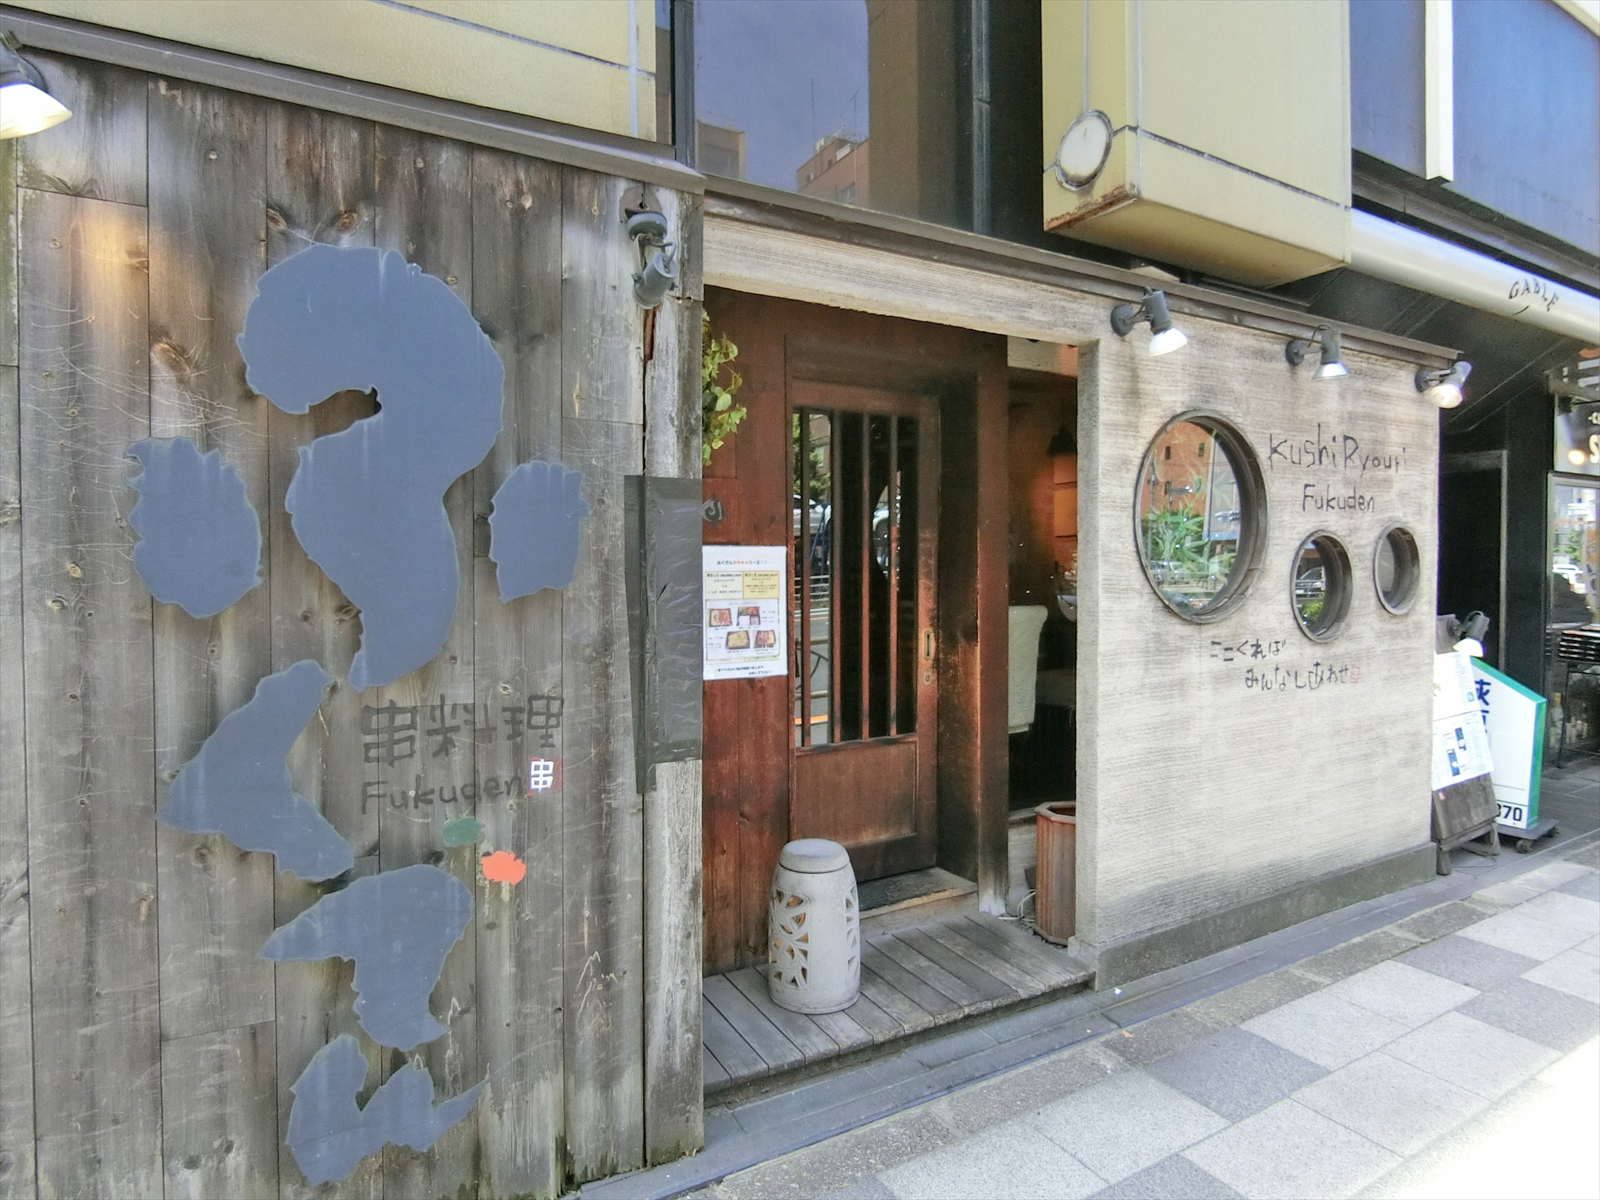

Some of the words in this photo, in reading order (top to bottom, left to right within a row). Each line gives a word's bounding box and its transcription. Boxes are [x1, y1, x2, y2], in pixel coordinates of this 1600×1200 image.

[1302, 483, 1375, 512] Fukuden
[361, 693, 565, 768] 串料理
[361, 770, 525, 815] Fukuden
[530, 758, 554, 793] 串
